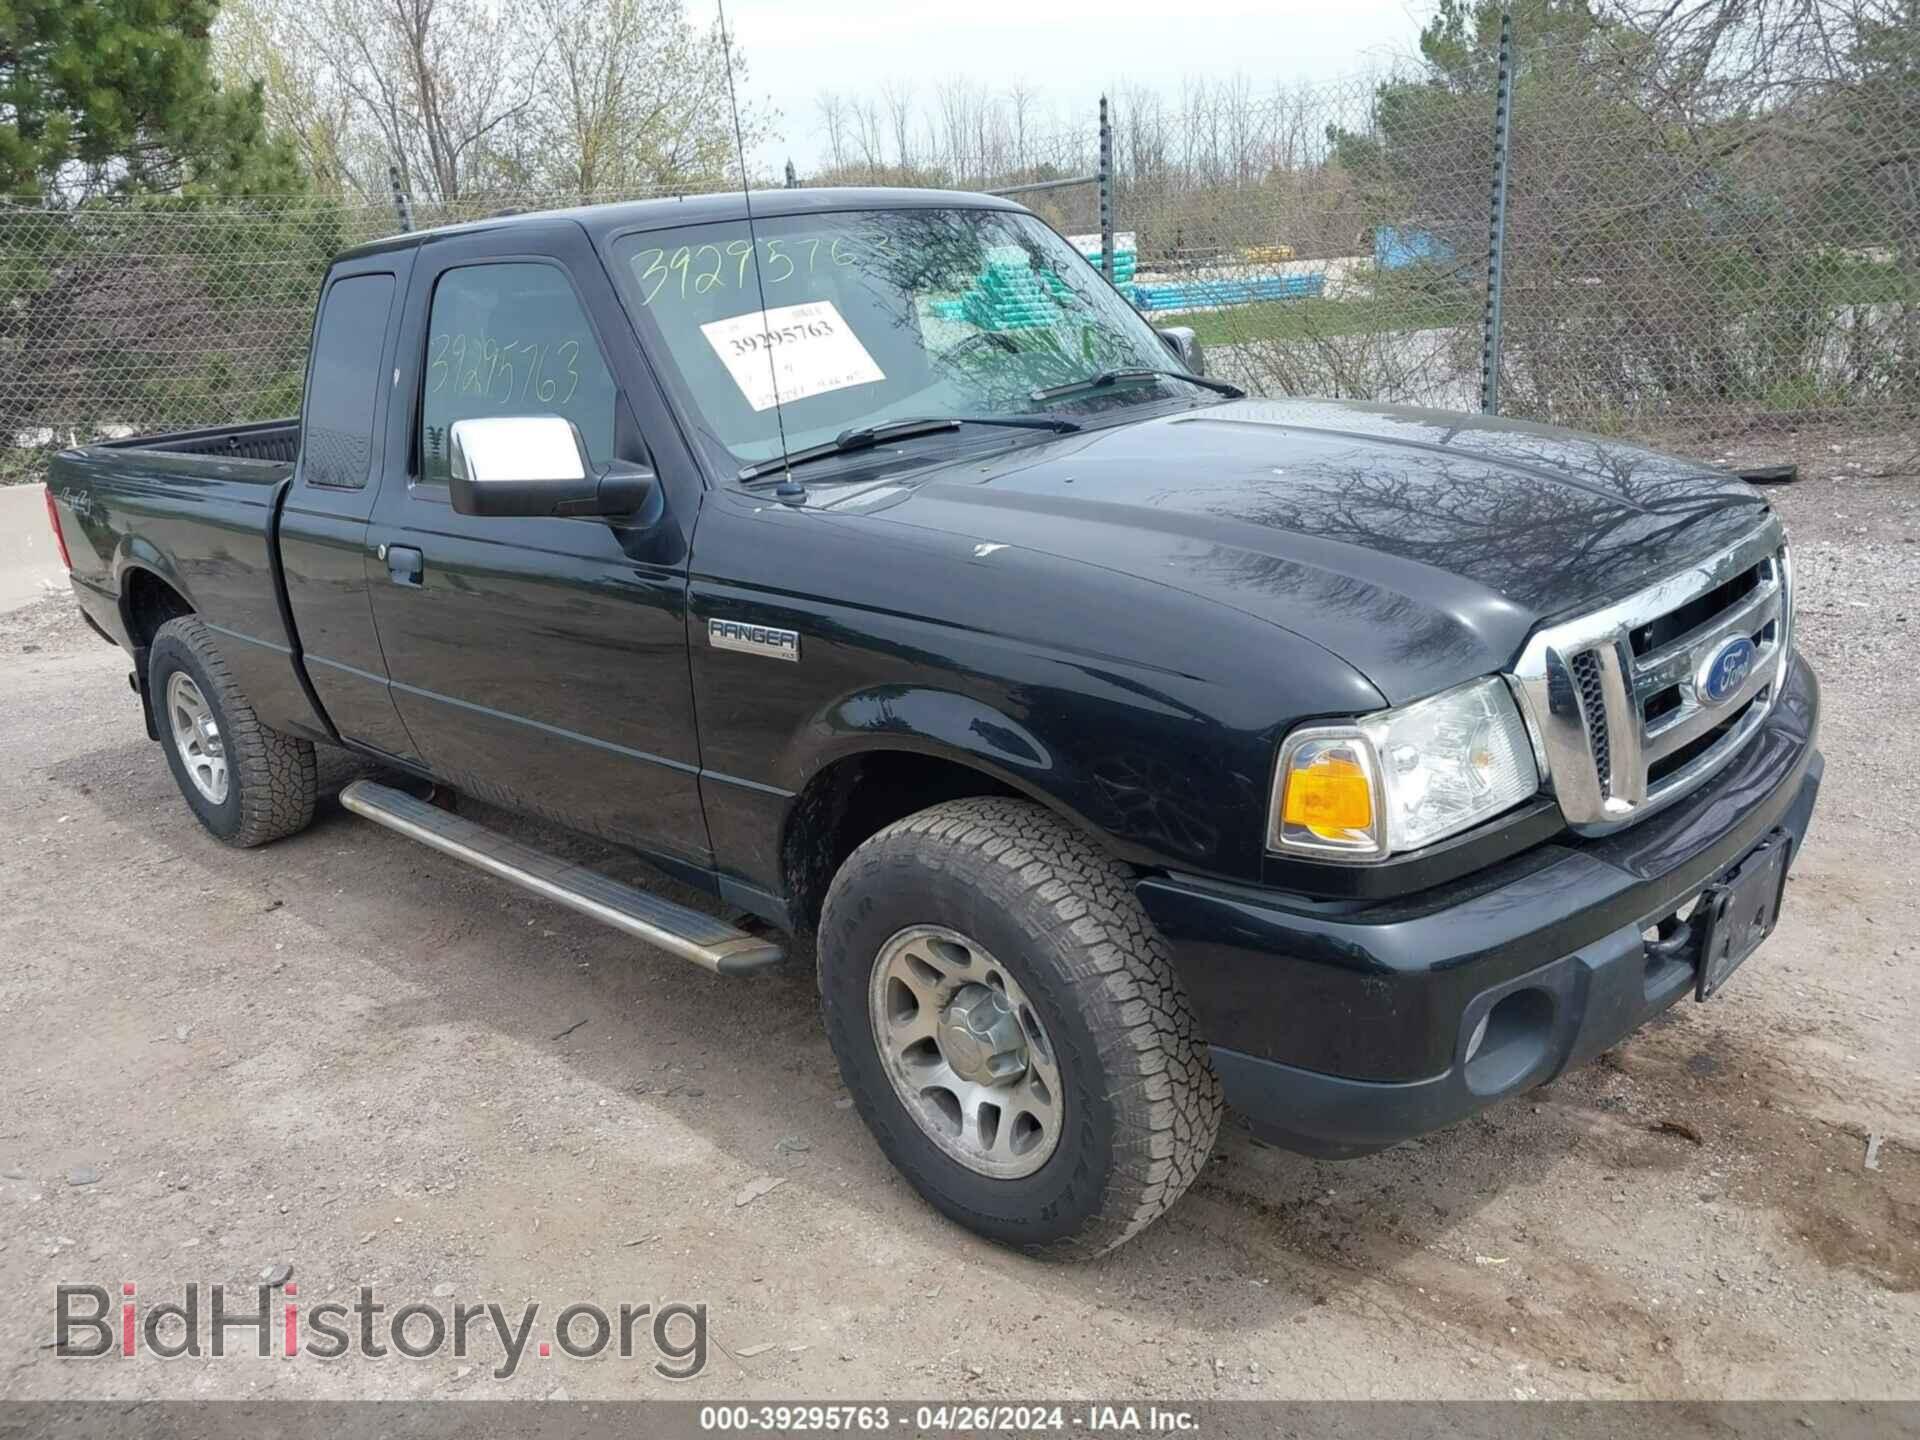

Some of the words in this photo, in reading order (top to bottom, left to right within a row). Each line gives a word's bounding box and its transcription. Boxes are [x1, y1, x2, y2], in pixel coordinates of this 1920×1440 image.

[729, 320, 835, 357] 39295763
[431, 330, 580, 404] 39295763
[710, 620, 796, 650] RANGER
[1720, 648, 1750, 692] Ford
